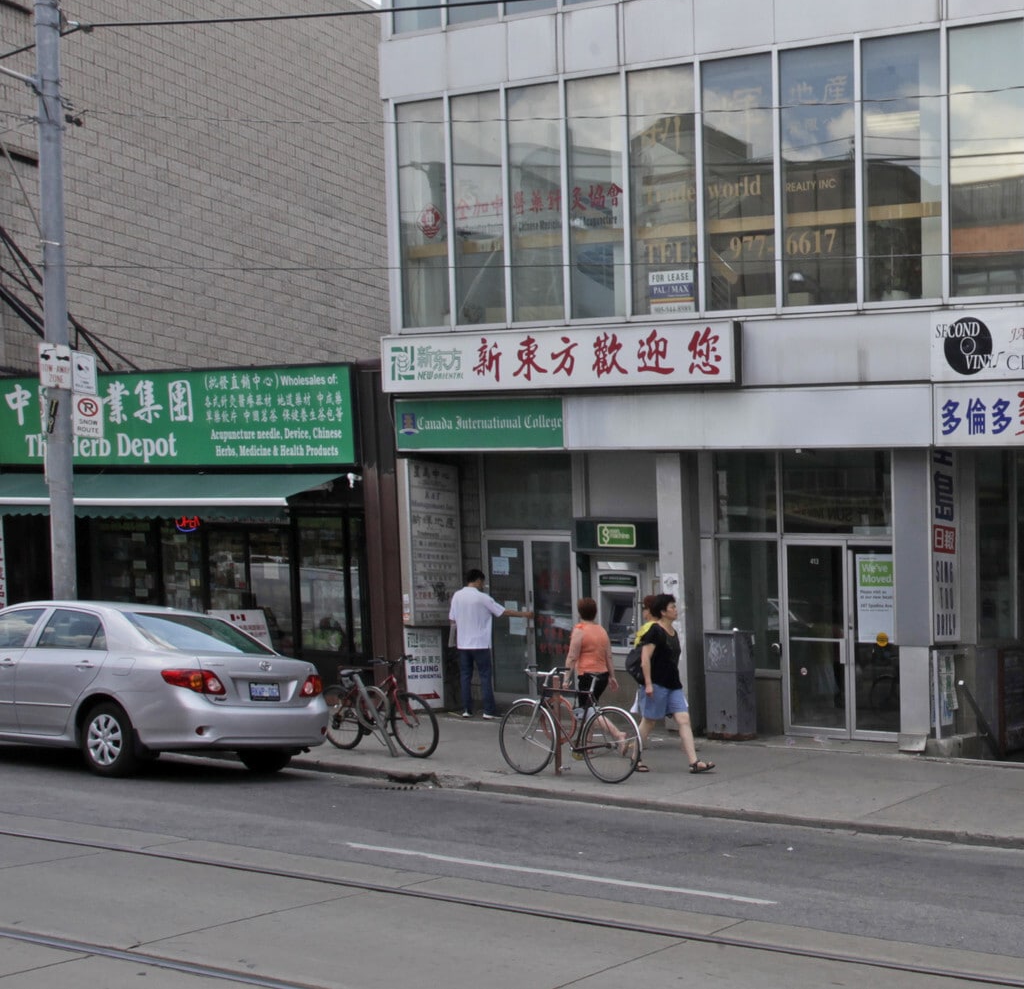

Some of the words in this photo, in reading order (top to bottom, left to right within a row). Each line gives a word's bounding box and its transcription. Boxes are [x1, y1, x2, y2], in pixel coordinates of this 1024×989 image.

[708, 174, 761, 198] world
[786, 180, 816, 194] REALTY
[818, 178, 837, 190] INC
[652, 274, 665, 283] FOR
[667, 272, 689, 282] LEASE
[935, 321, 981, 339] SECOND
[472, 326, 723, 383] 新東方歡迎您
[965, 351, 1006, 371] VINYL
[280, 374, 326, 386] Wholesales
[417, 371, 433, 381] NEW
[434, 372, 464, 381] ORIENTAL
[5, 379, 195, 427] 中業集團
[416, 415, 453, 430] Canada
[455, 414, 522, 430] International
[524, 413, 563, 431] College
[211, 429, 255, 443] Acupuncture
[257, 428, 283, 440] needle,
[284, 428, 311, 440] Device,
[312, 427, 342, 439] Chinese
[25, 433, 47, 458] Th
[117, 432, 178, 463] Depot
[215, 445, 238, 457] Herbs,
[239, 445, 271, 456] Medicine
[272, 445, 279, 456] &
[280, 444, 304, 456] Health
[306, 444, 339, 456] Products
[934, 527, 954, 550] 日報
[861, 563, 889, 573] We've
[936, 560, 954, 584] SING
[862, 574, 892, 583] Moved
[939, 588, 954, 610] TAO
[936, 614, 956, 637] DAILY
[410, 665, 439, 673] BEIJING
